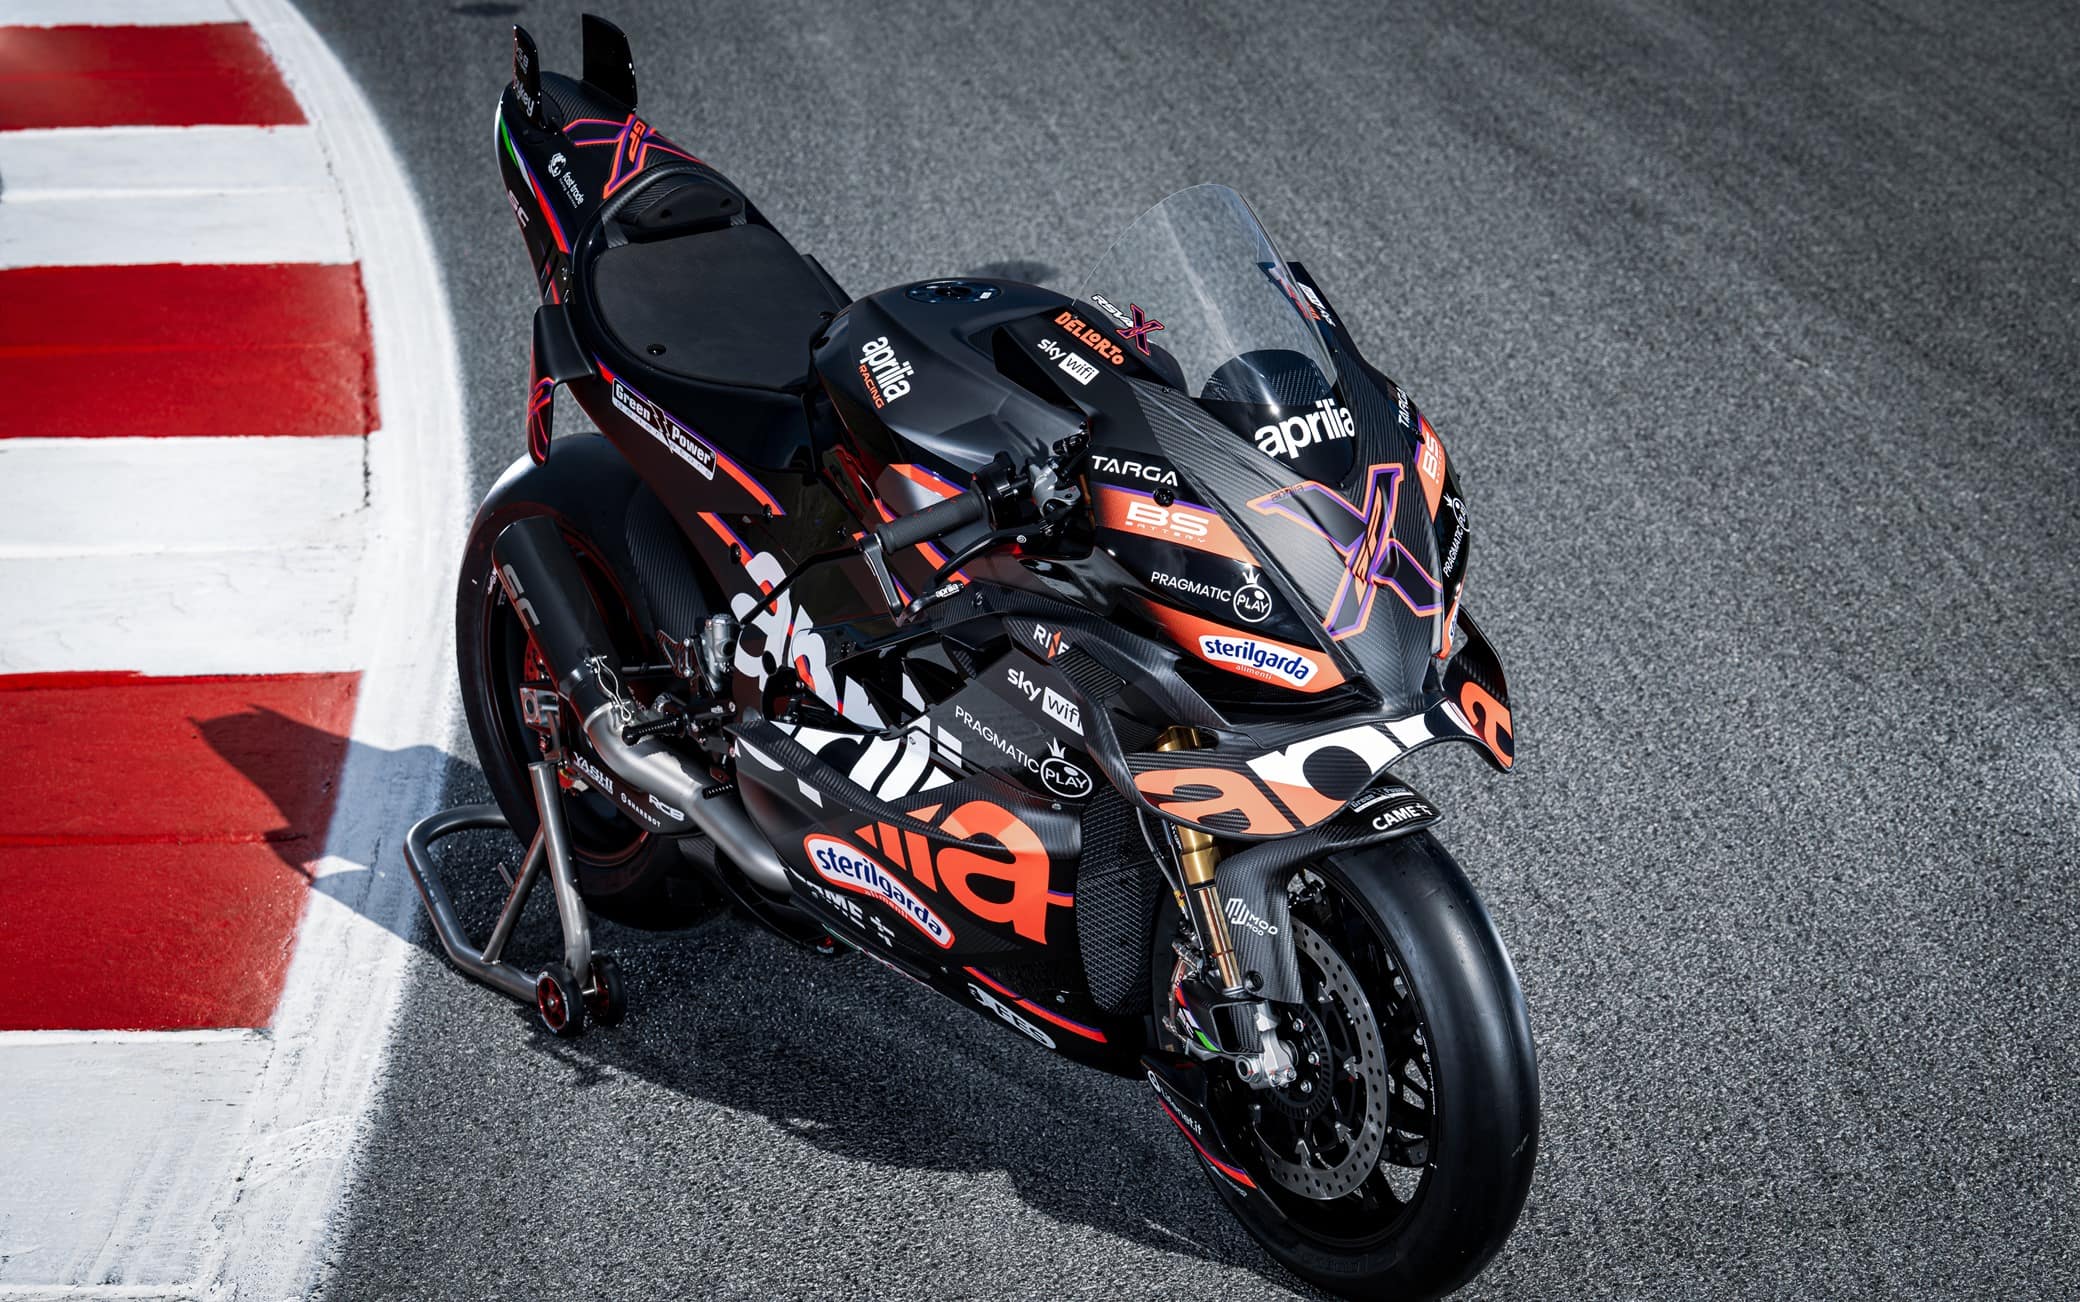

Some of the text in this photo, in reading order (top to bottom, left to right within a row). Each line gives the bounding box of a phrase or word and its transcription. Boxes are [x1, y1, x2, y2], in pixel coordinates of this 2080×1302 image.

[562, 171, 577, 189] fast
[570, 183, 585, 206] trade
[860, 336, 915, 404] aprilia
[1037, 338, 1096, 381] sky wifi
[858, 363, 885, 409] RACING
[615, 383, 651, 421] Green
[671, 425, 711, 465] Power
[1254, 398, 1355, 459] aprilia
[1091, 455, 1178, 487] TARGA
[1125, 519, 1206, 544] BATTERY
[1126, 501, 1210, 537] BS
[1150, 571, 1269, 614] PRAGMATIC PLAY
[1205, 639, 1310, 680] sterilgarda
[1235, 664, 1273, 680] alimenti
[1007, 668, 1042, 702] sky
[955, 704, 1088, 790] PRAGMATIC PLAY
[648, 793, 685, 822] RCB
[1372, 805, 1421, 831] CAME
[816, 847, 943, 937] sterilgarda
[1248, 913, 1279, 936] MOD
